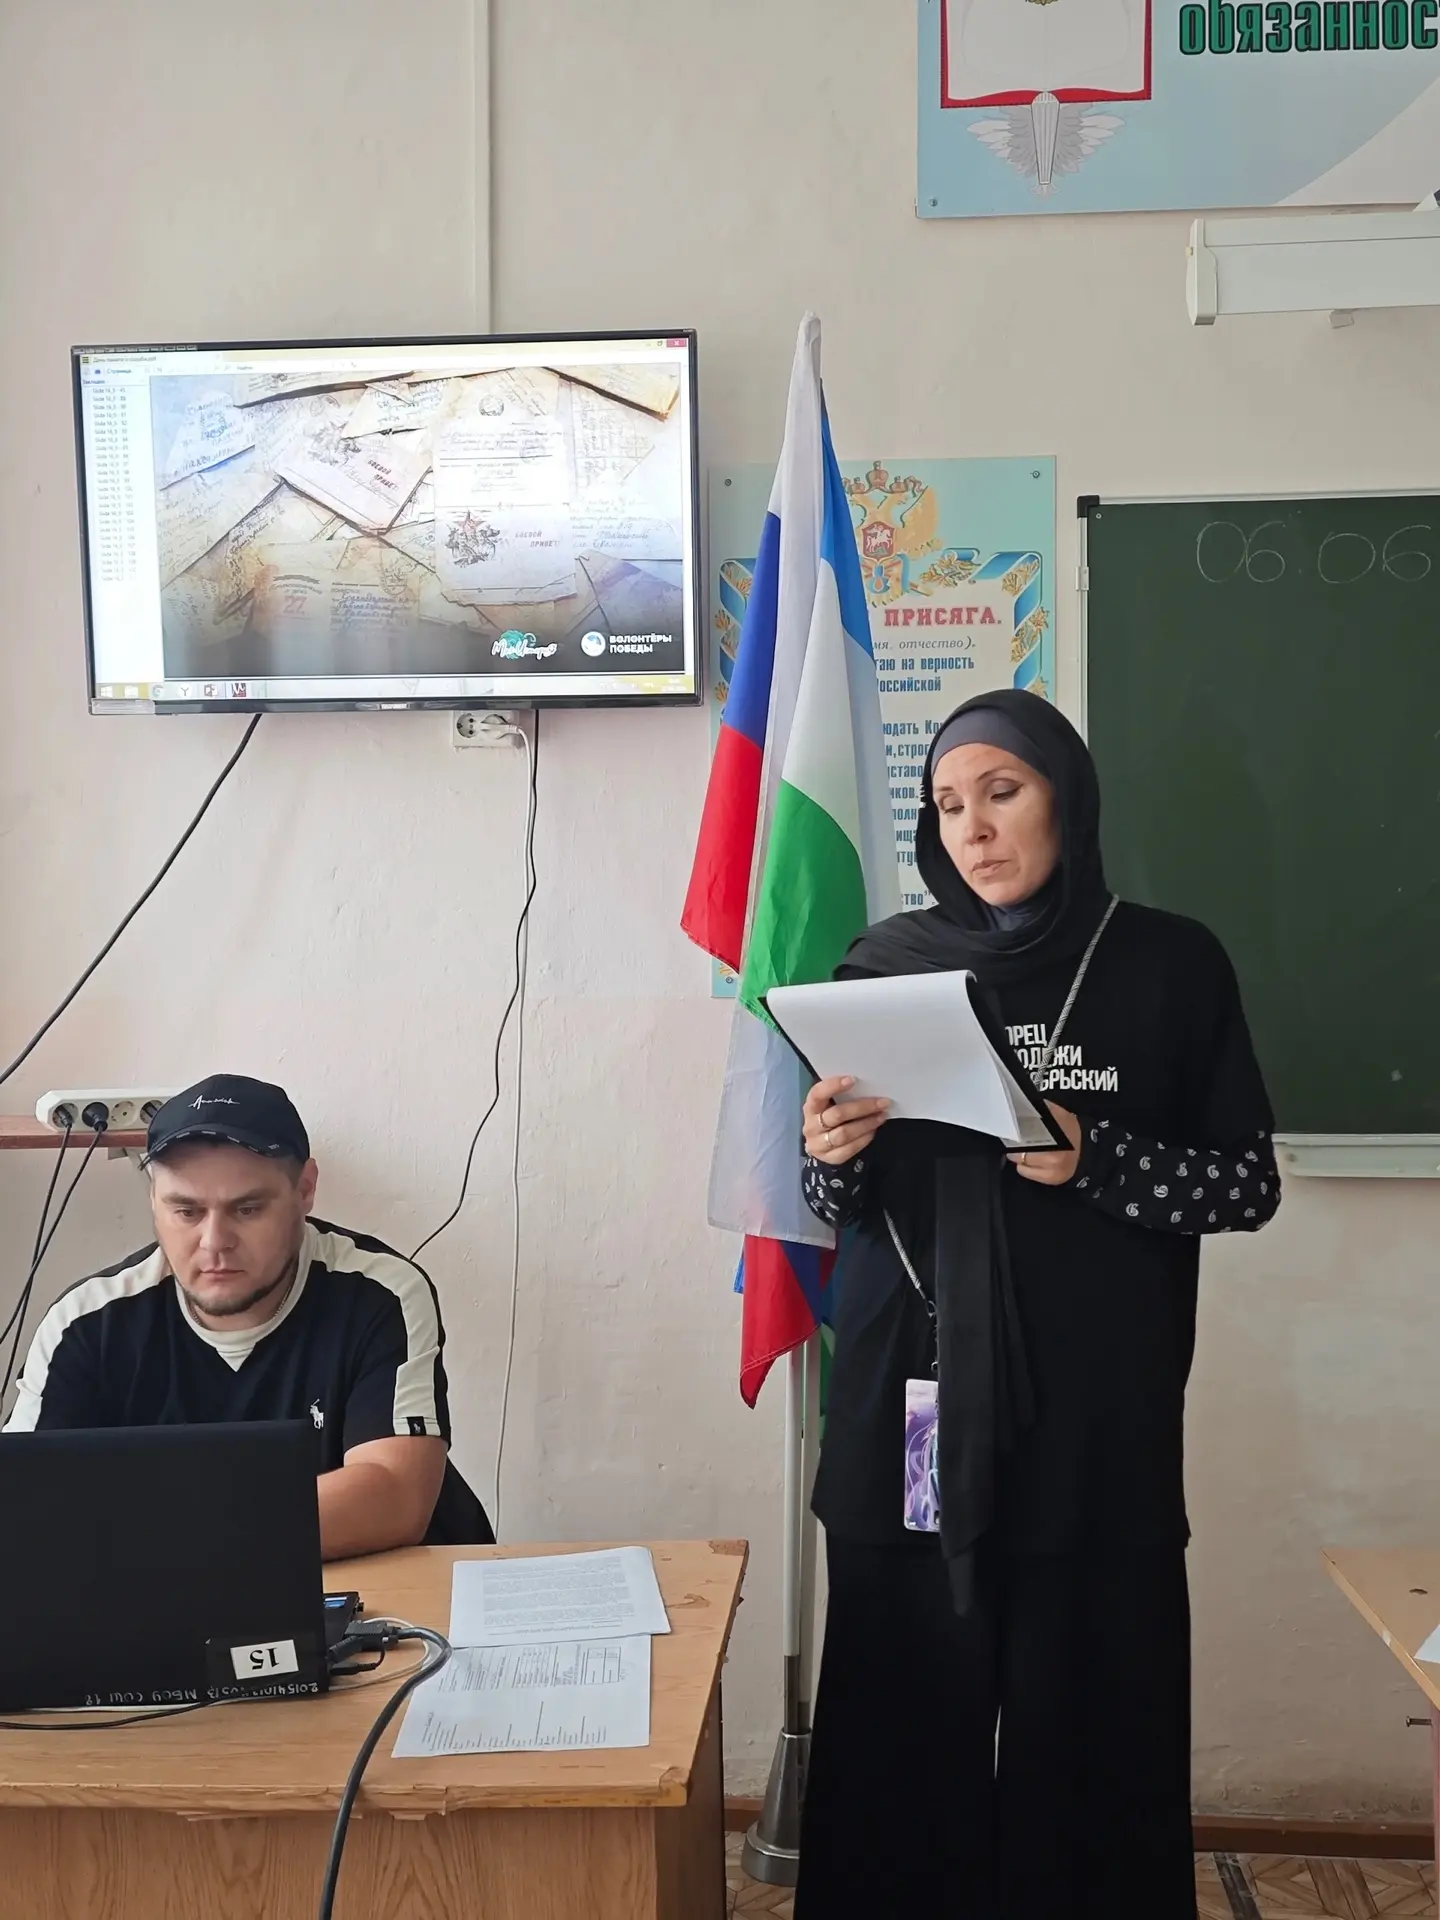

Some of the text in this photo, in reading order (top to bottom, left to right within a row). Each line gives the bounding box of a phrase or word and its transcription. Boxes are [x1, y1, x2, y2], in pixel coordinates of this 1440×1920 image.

[1179, 0, 1440, 55] обязаннос
[884, 605, 1002, 627] ПРИСЯГА.
[609, 632, 673, 644] ВОЛОНТЁРЫ
[609, 644, 654, 655] ПОБЕДЫ
[901, 658, 915, 671] на
[920, 657, 975, 673] верность
[878, 676, 942, 693] оссийской
[249, 1646, 280, 1671] 15
